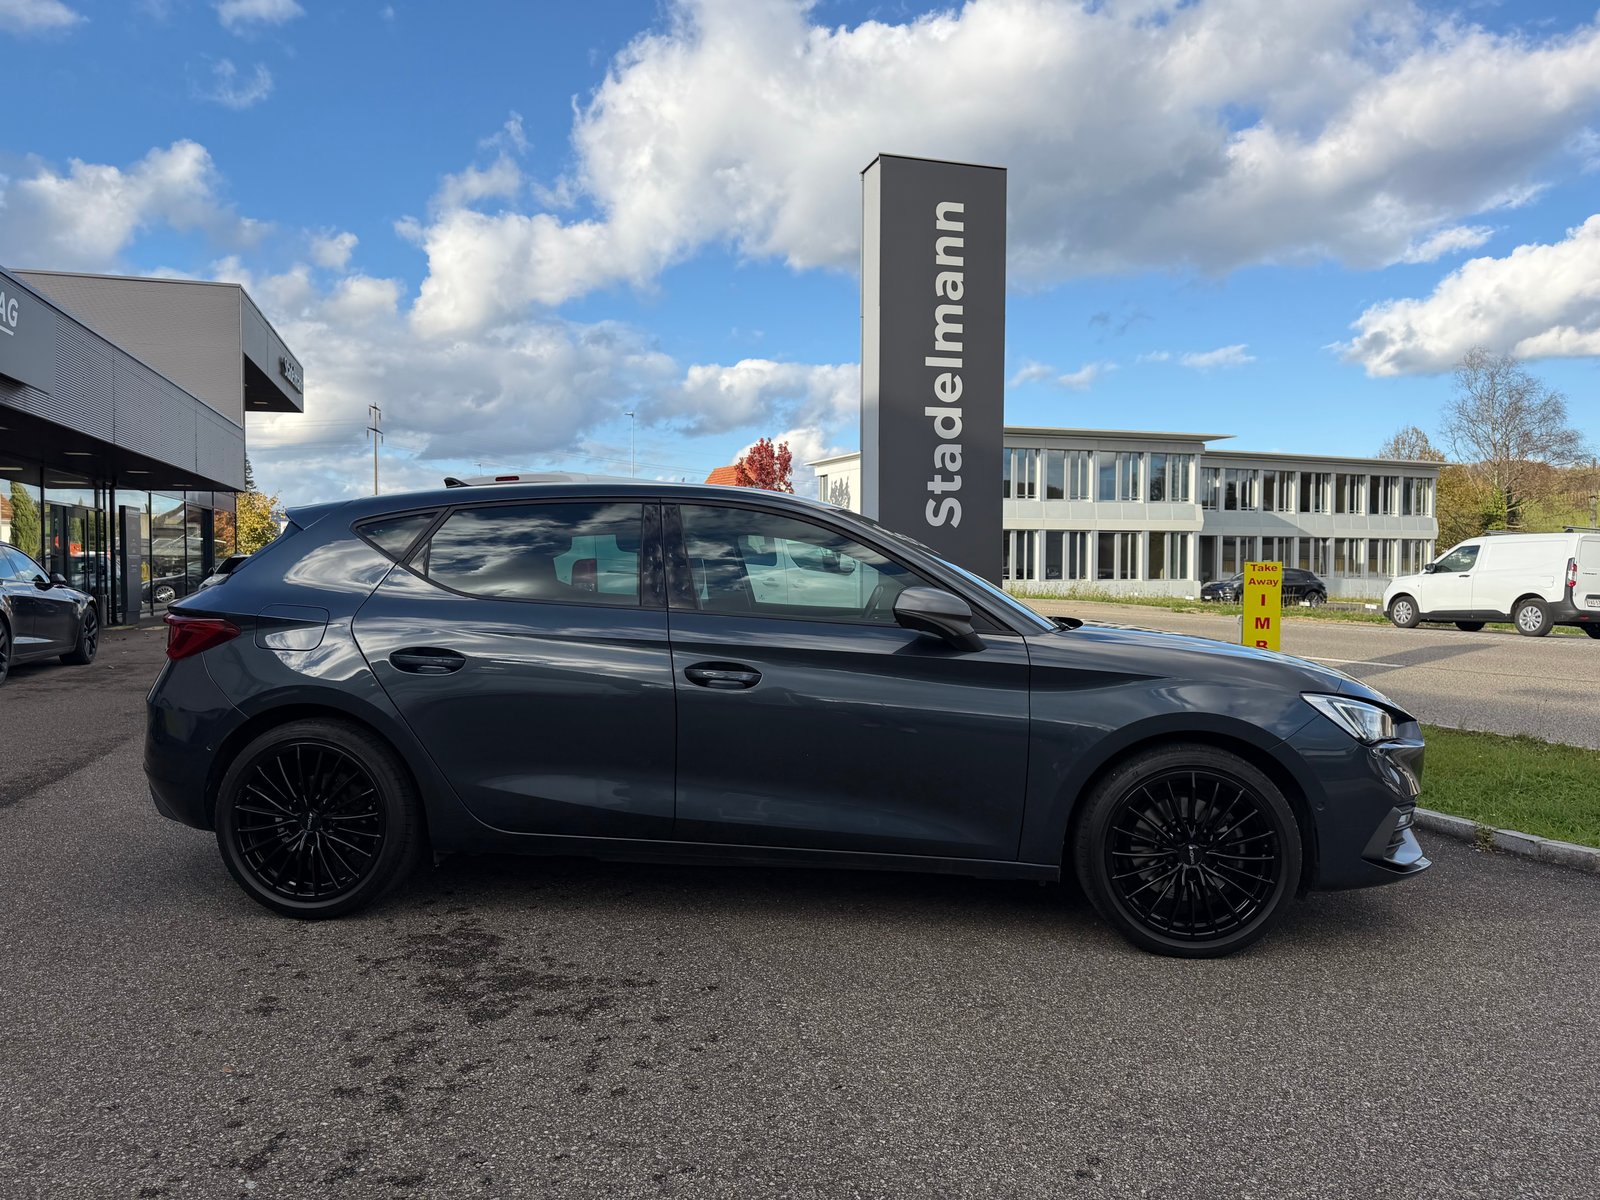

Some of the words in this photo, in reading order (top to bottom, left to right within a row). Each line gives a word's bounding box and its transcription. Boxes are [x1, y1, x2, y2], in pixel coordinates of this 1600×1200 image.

[925, 200, 965, 528] Stadelmann
[1250, 564, 1278, 572] Take
[1248, 578, 1279, 587] Away
